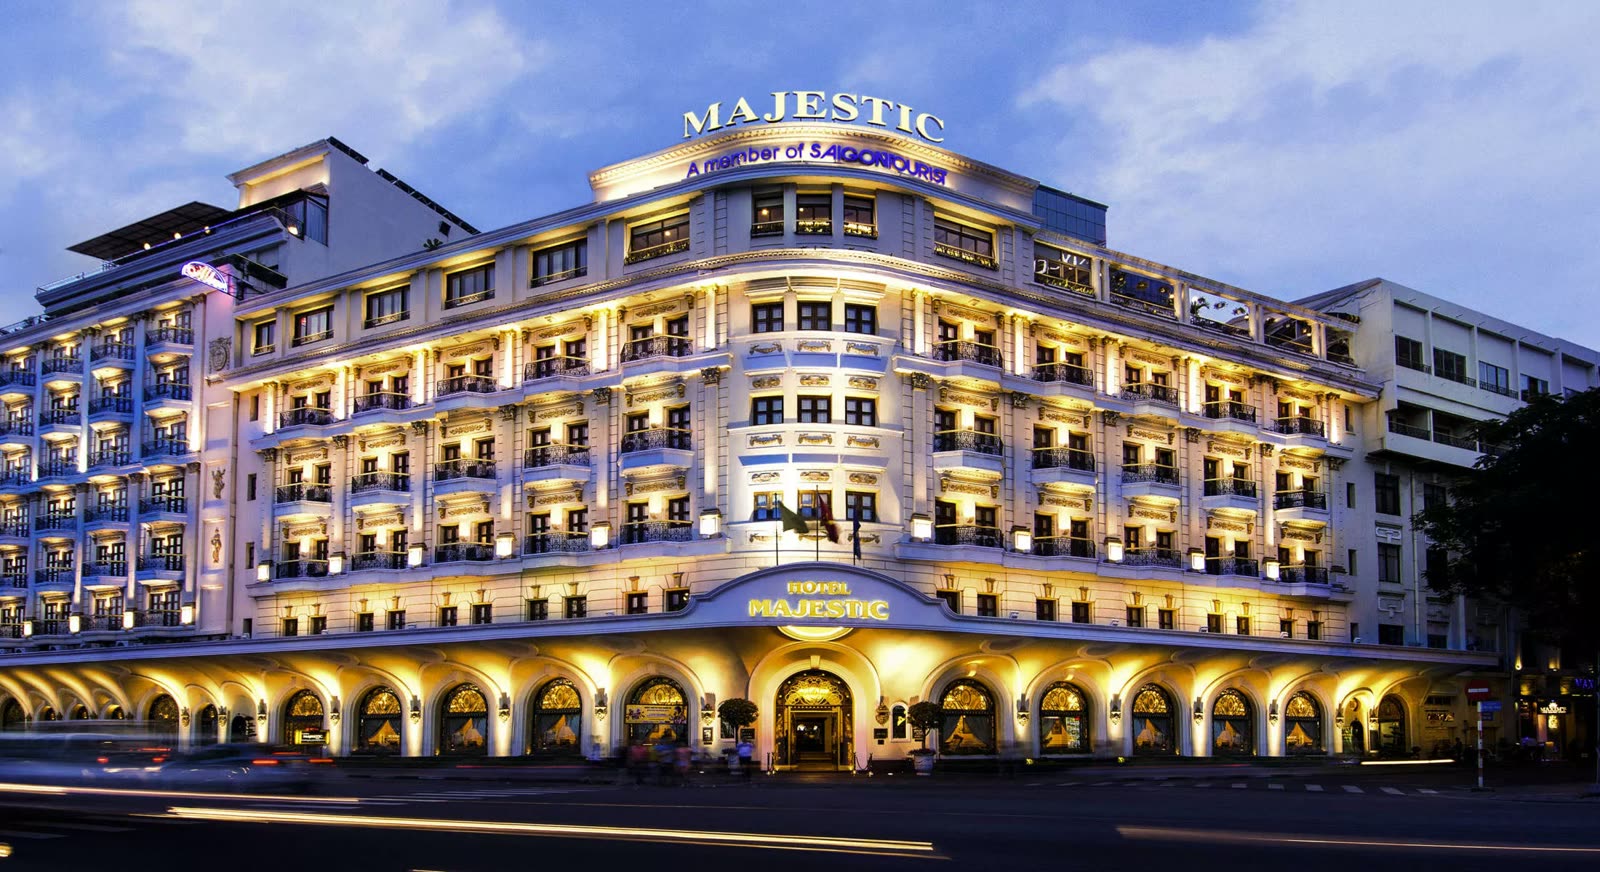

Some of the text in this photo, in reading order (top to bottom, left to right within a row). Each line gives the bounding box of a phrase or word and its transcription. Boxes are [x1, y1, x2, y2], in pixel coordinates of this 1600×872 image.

[682, 90, 945, 143] MAJESTIC
[686, 142, 948, 185] A member of SAIGONTOURIST
[787, 581, 852, 596] HOTEL
[748, 598, 890, 620] MAJESTIC
